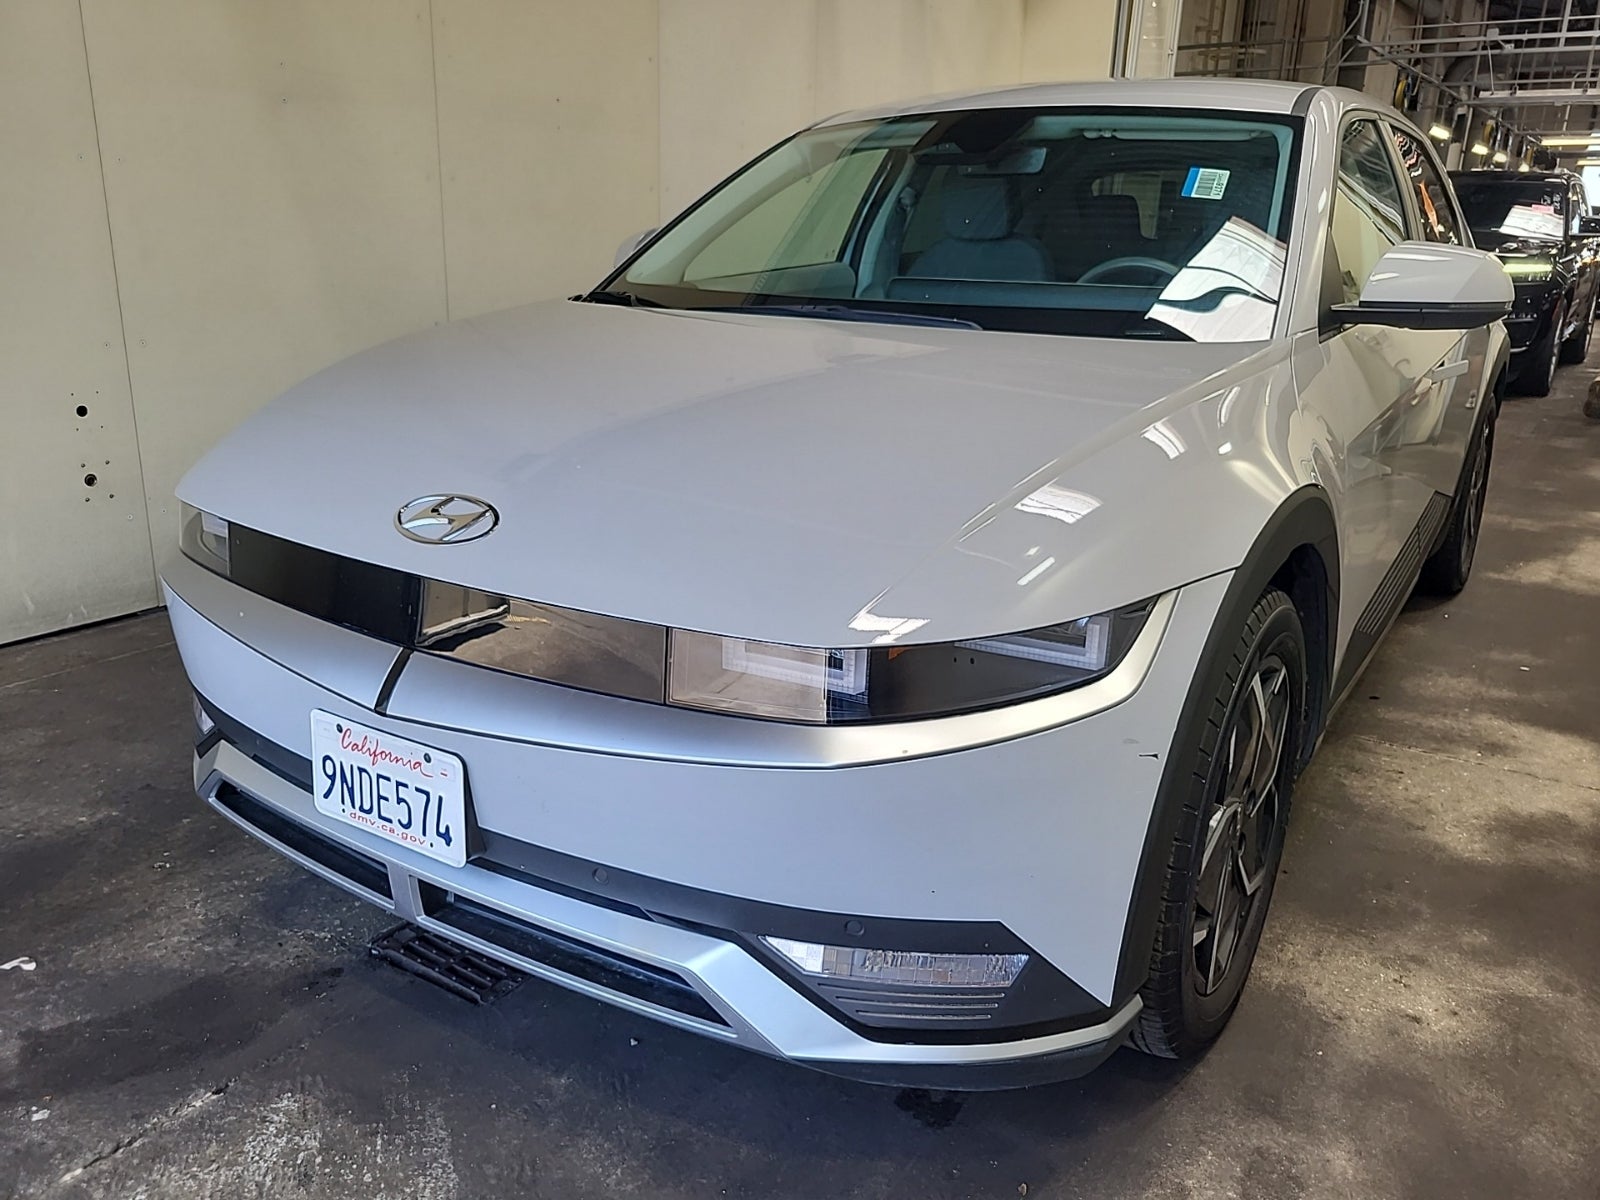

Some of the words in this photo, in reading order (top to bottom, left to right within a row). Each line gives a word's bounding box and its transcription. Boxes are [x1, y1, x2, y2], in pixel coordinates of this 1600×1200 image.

[341, 728, 433, 777] California
[322, 755, 452, 847] 9NDE574
[350, 812, 426, 845] dmv.ca.gov
